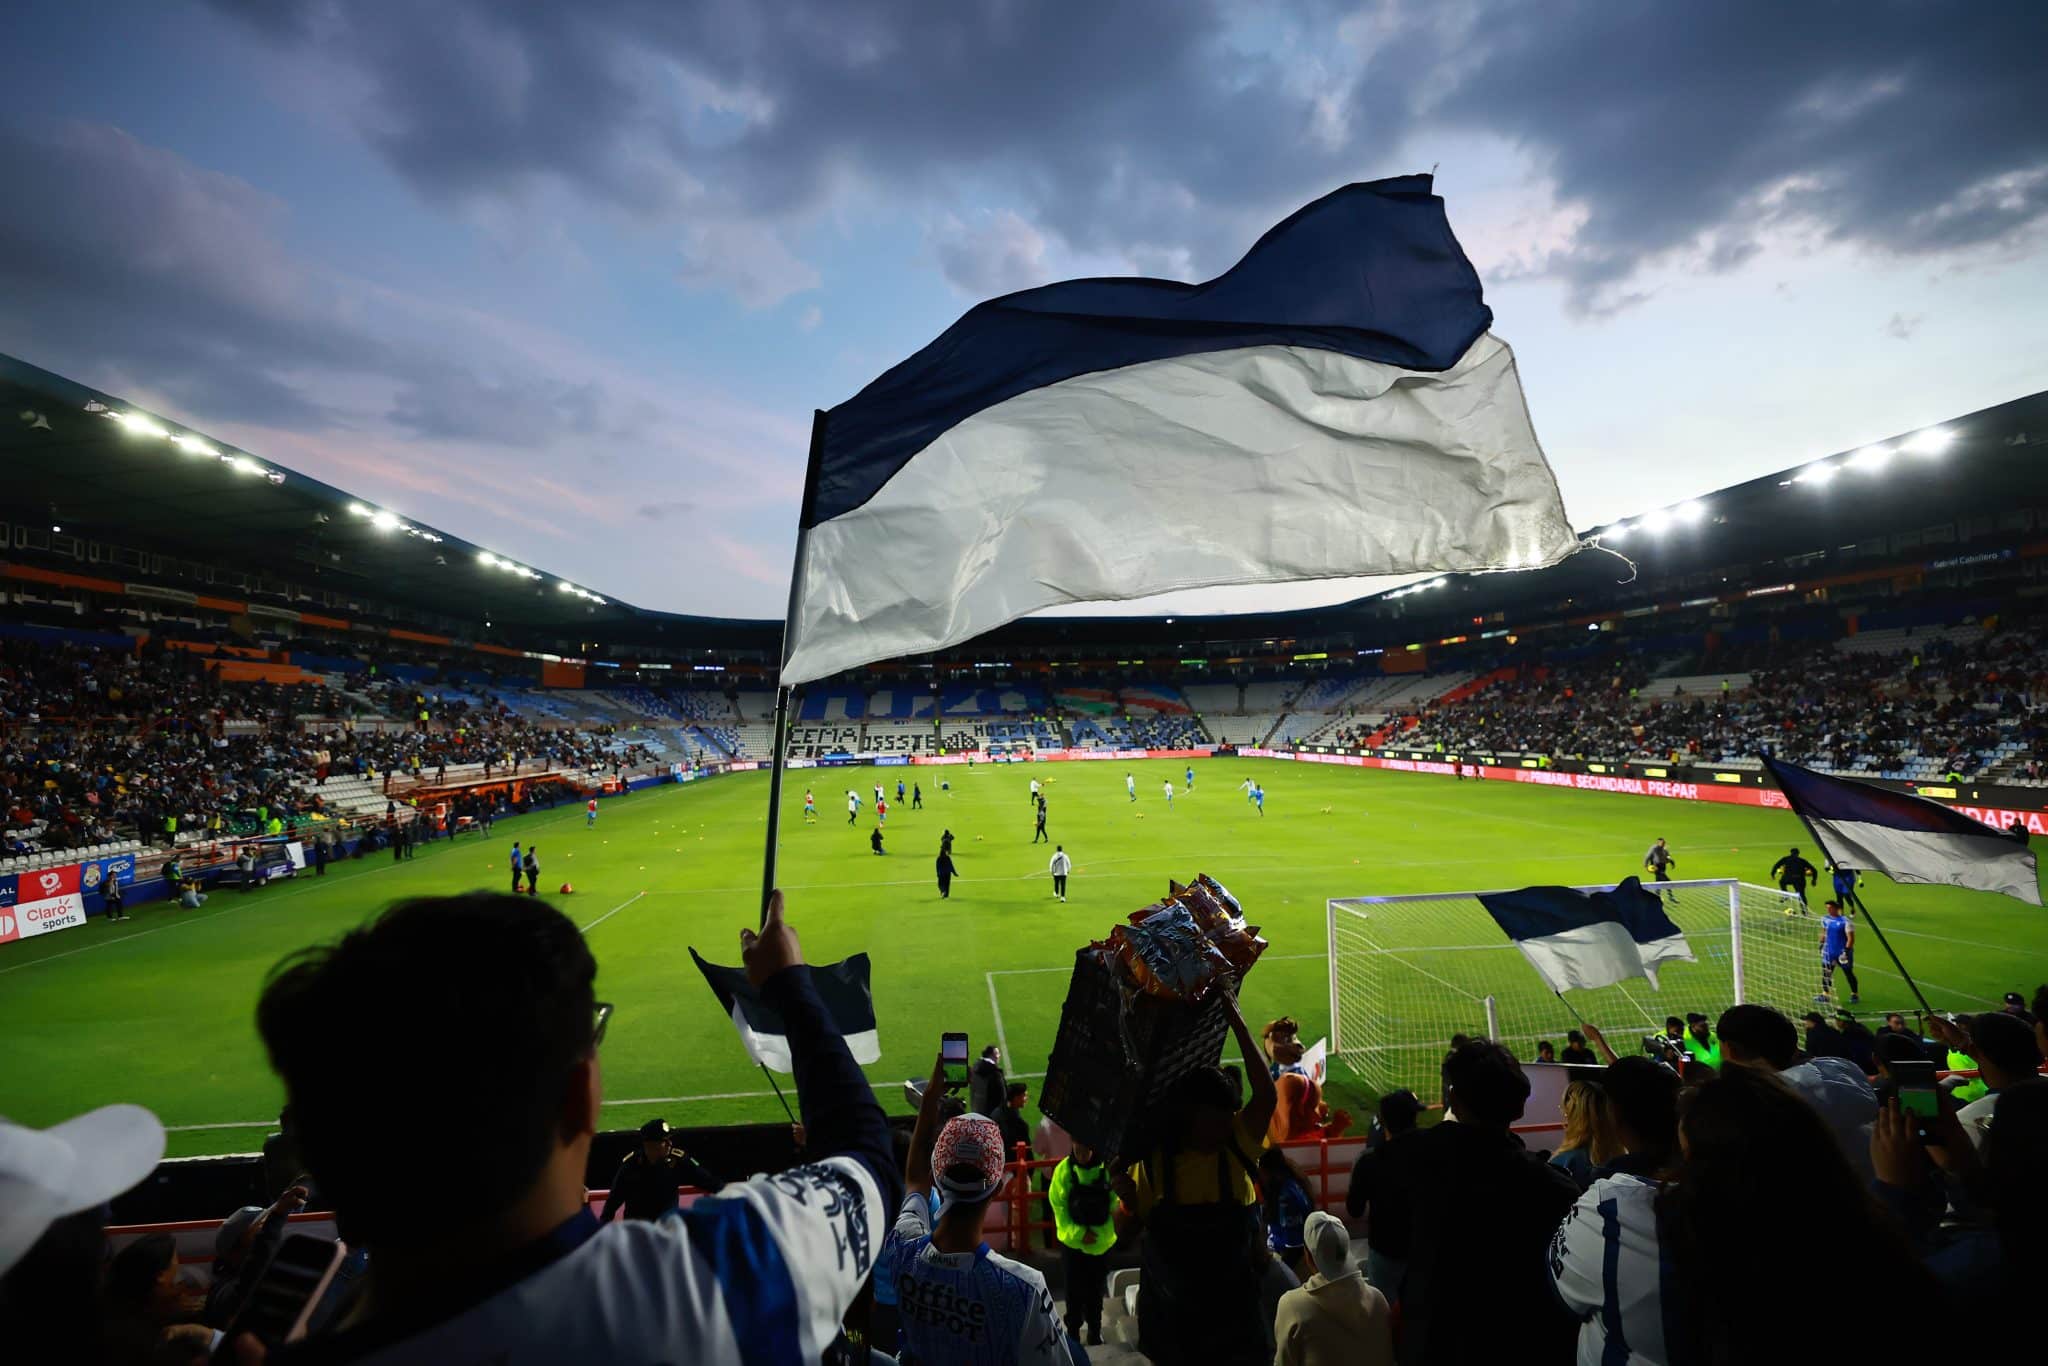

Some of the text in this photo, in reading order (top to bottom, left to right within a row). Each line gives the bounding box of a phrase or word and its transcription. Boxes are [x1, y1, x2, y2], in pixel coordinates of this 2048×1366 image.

[27, 902, 68, 922] Claro
[42, 914, 77, 931] sports
[899, 1272, 987, 1323] Office
[900, 1294, 984, 1342] DEPOT
